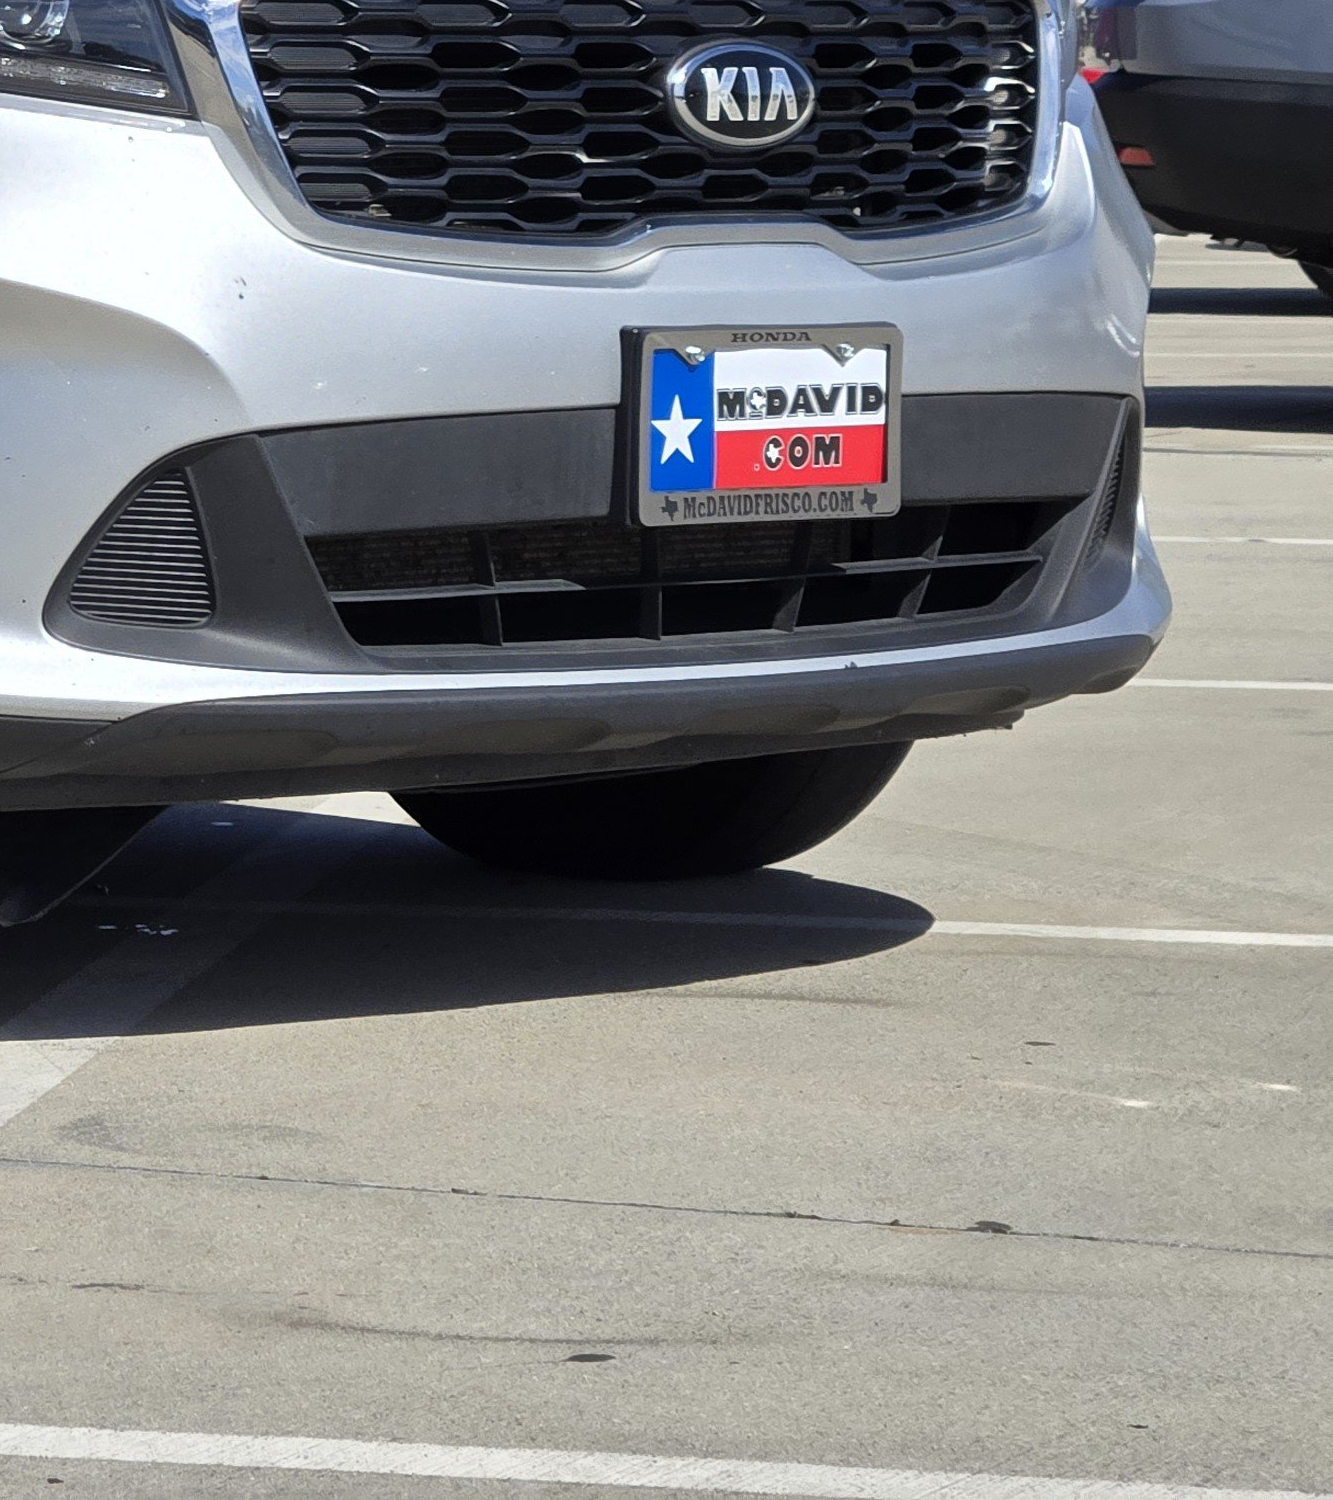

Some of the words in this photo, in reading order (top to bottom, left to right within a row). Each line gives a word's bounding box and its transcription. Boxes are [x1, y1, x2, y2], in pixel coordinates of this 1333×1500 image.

[701, 66, 798, 122] KIA
[731, 332, 812, 343] HONDA
[683, 491, 854, 519] McDAVIDFRISCO.COM
